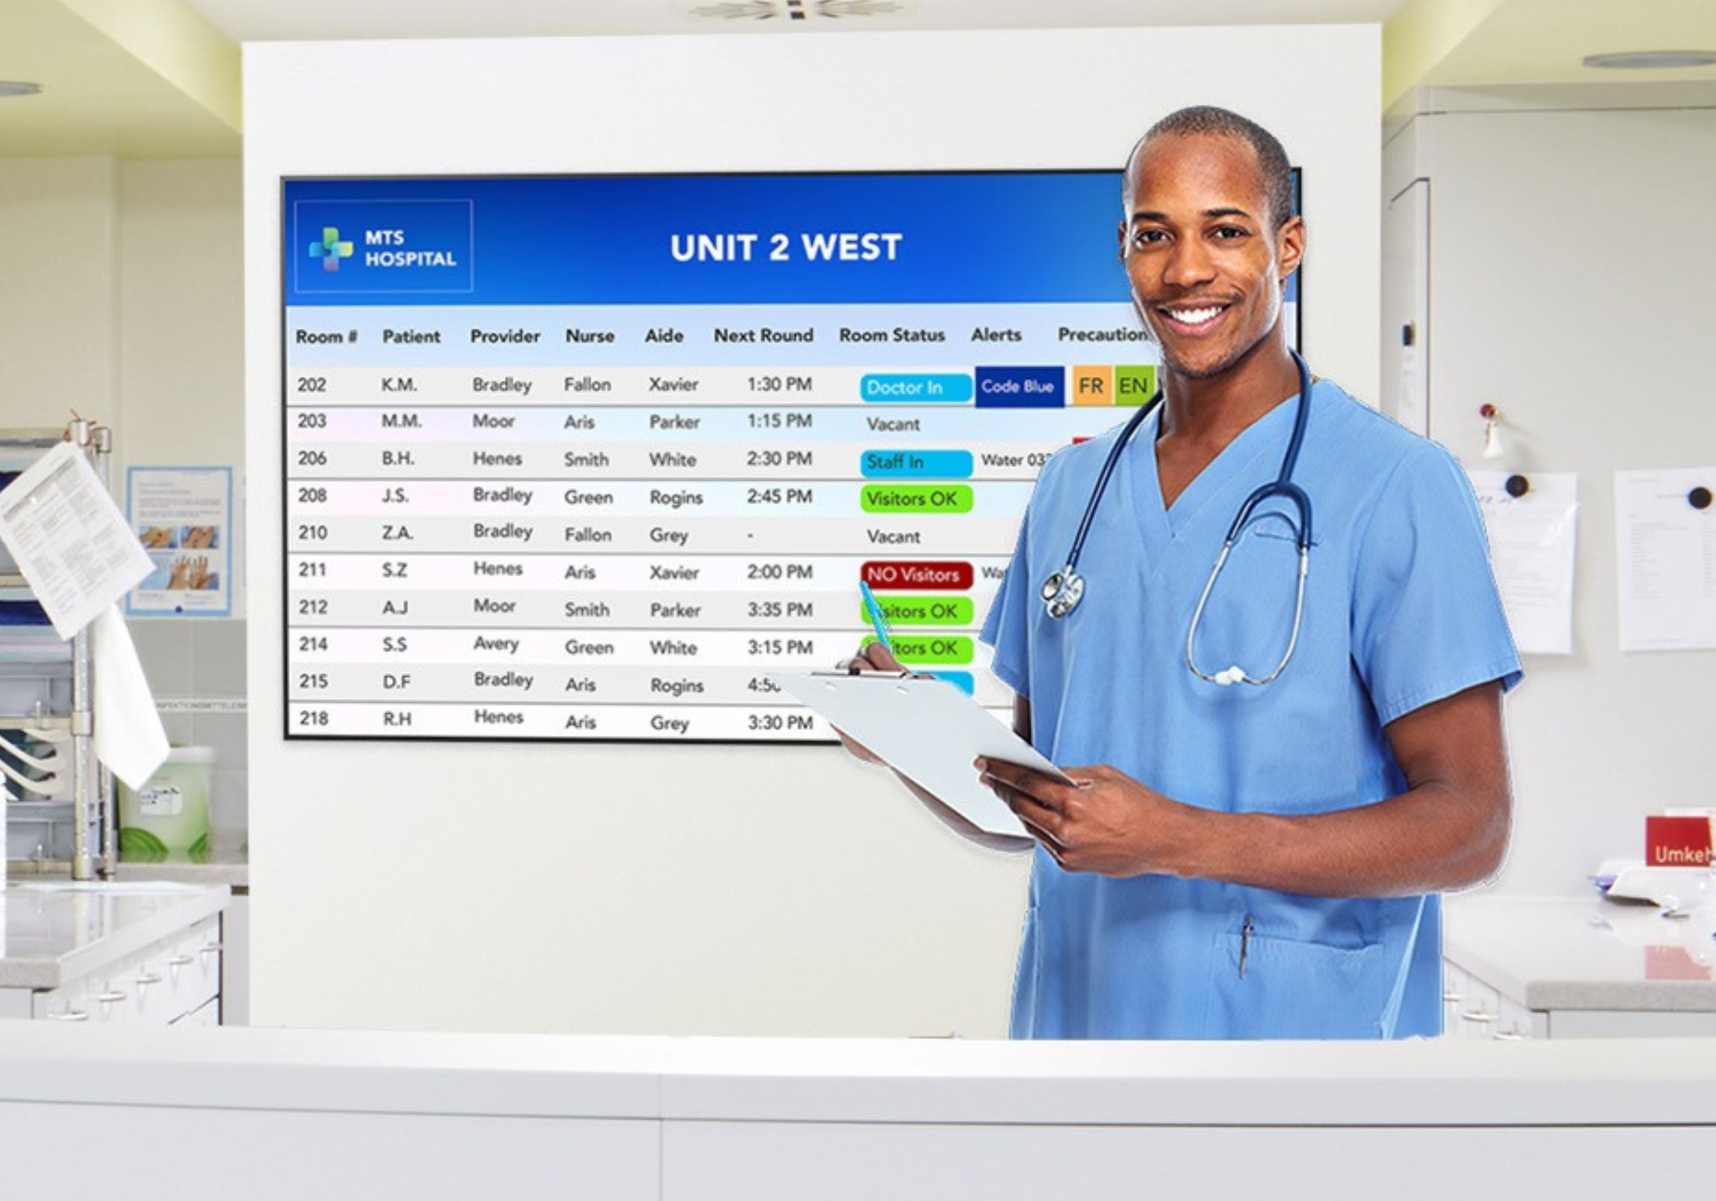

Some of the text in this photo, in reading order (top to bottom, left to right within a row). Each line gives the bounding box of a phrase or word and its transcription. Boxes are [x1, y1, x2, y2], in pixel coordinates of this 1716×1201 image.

[366, 230, 405, 245] MTS
[671, 233, 903, 262] UNIT 2 WEST
[366, 251, 457, 267] HOSPITAL
[296, 326, 1152, 345] Room # Patient Provider Nurse Aide Next Round Room Status Alerts Precaution
[298, 377, 327, 392] 202
[382, 377, 418, 392] K.M.
[473, 377, 533, 397] Bradley
[565, 377, 612, 393] Fallon
[649, 377, 700, 392] Xavier
[748, 376, 782, 392] 1:30
[786, 376, 813, 391] PM
[867, 379, 921, 396] Doctor
[924, 379, 943, 396] In
[981, 379, 1020, 394] Code
[1023, 379, 1055, 394] Blue
[1079, 377, 1104, 394] FR
[1119, 377, 1148, 394] EN
[298, 413, 921, 432] 203 M.M. Moor Aris Parker 1:15 PM Vacant
[298, 450, 328, 466] 206
[382, 450, 416, 466] B.H.
[473, 451, 524, 467] Henes
[564, 451, 610, 468] Smith
[649, 451, 698, 468] White
[747, 450, 782, 466] 2:30
[786, 450, 813, 466] PM
[867, 454, 903, 469] Staff
[907, 454, 925, 469] In
[981, 453, 1023, 466] Water
[299, 487, 958, 510] 208 J.S. Bradley Green Rogins 2:45 PM Visitors OK
[299, 525, 328, 541] 210
[382, 525, 414, 541] Z.A.
[474, 523, 534, 543] Bradley
[565, 526, 613, 543] Fallon
[650, 527, 690, 547] Grey
[867, 529, 921, 545] Vacant
[299, 562, 326, 578] 211
[382, 562, 408, 578] S.Z
[474, 561, 524, 577] Henes
[565, 564, 597, 581] Aris
[650, 564, 701, 581] Xavier
[748, 564, 782, 580] 2:00
[786, 564, 813, 579] PM
[867, 567, 897, 583] NO
[900, 567, 961, 583] Visitors
[299, 598, 958, 620] 212 A.J Moor Smith Parker 3:35 PM sitors OK
[299, 635, 958, 656] 214 S.S Avery Green White 3:15 PM itors OK
[300, 673, 329, 690] 215
[383, 673, 411, 690] D.F
[474, 671, 535, 692] Bradley
[565, 676, 597, 693] Aris
[651, 677, 705, 698] Rogins
[300, 709, 814, 735] 218 R.H Henes Aris Grey 3:30 PM
